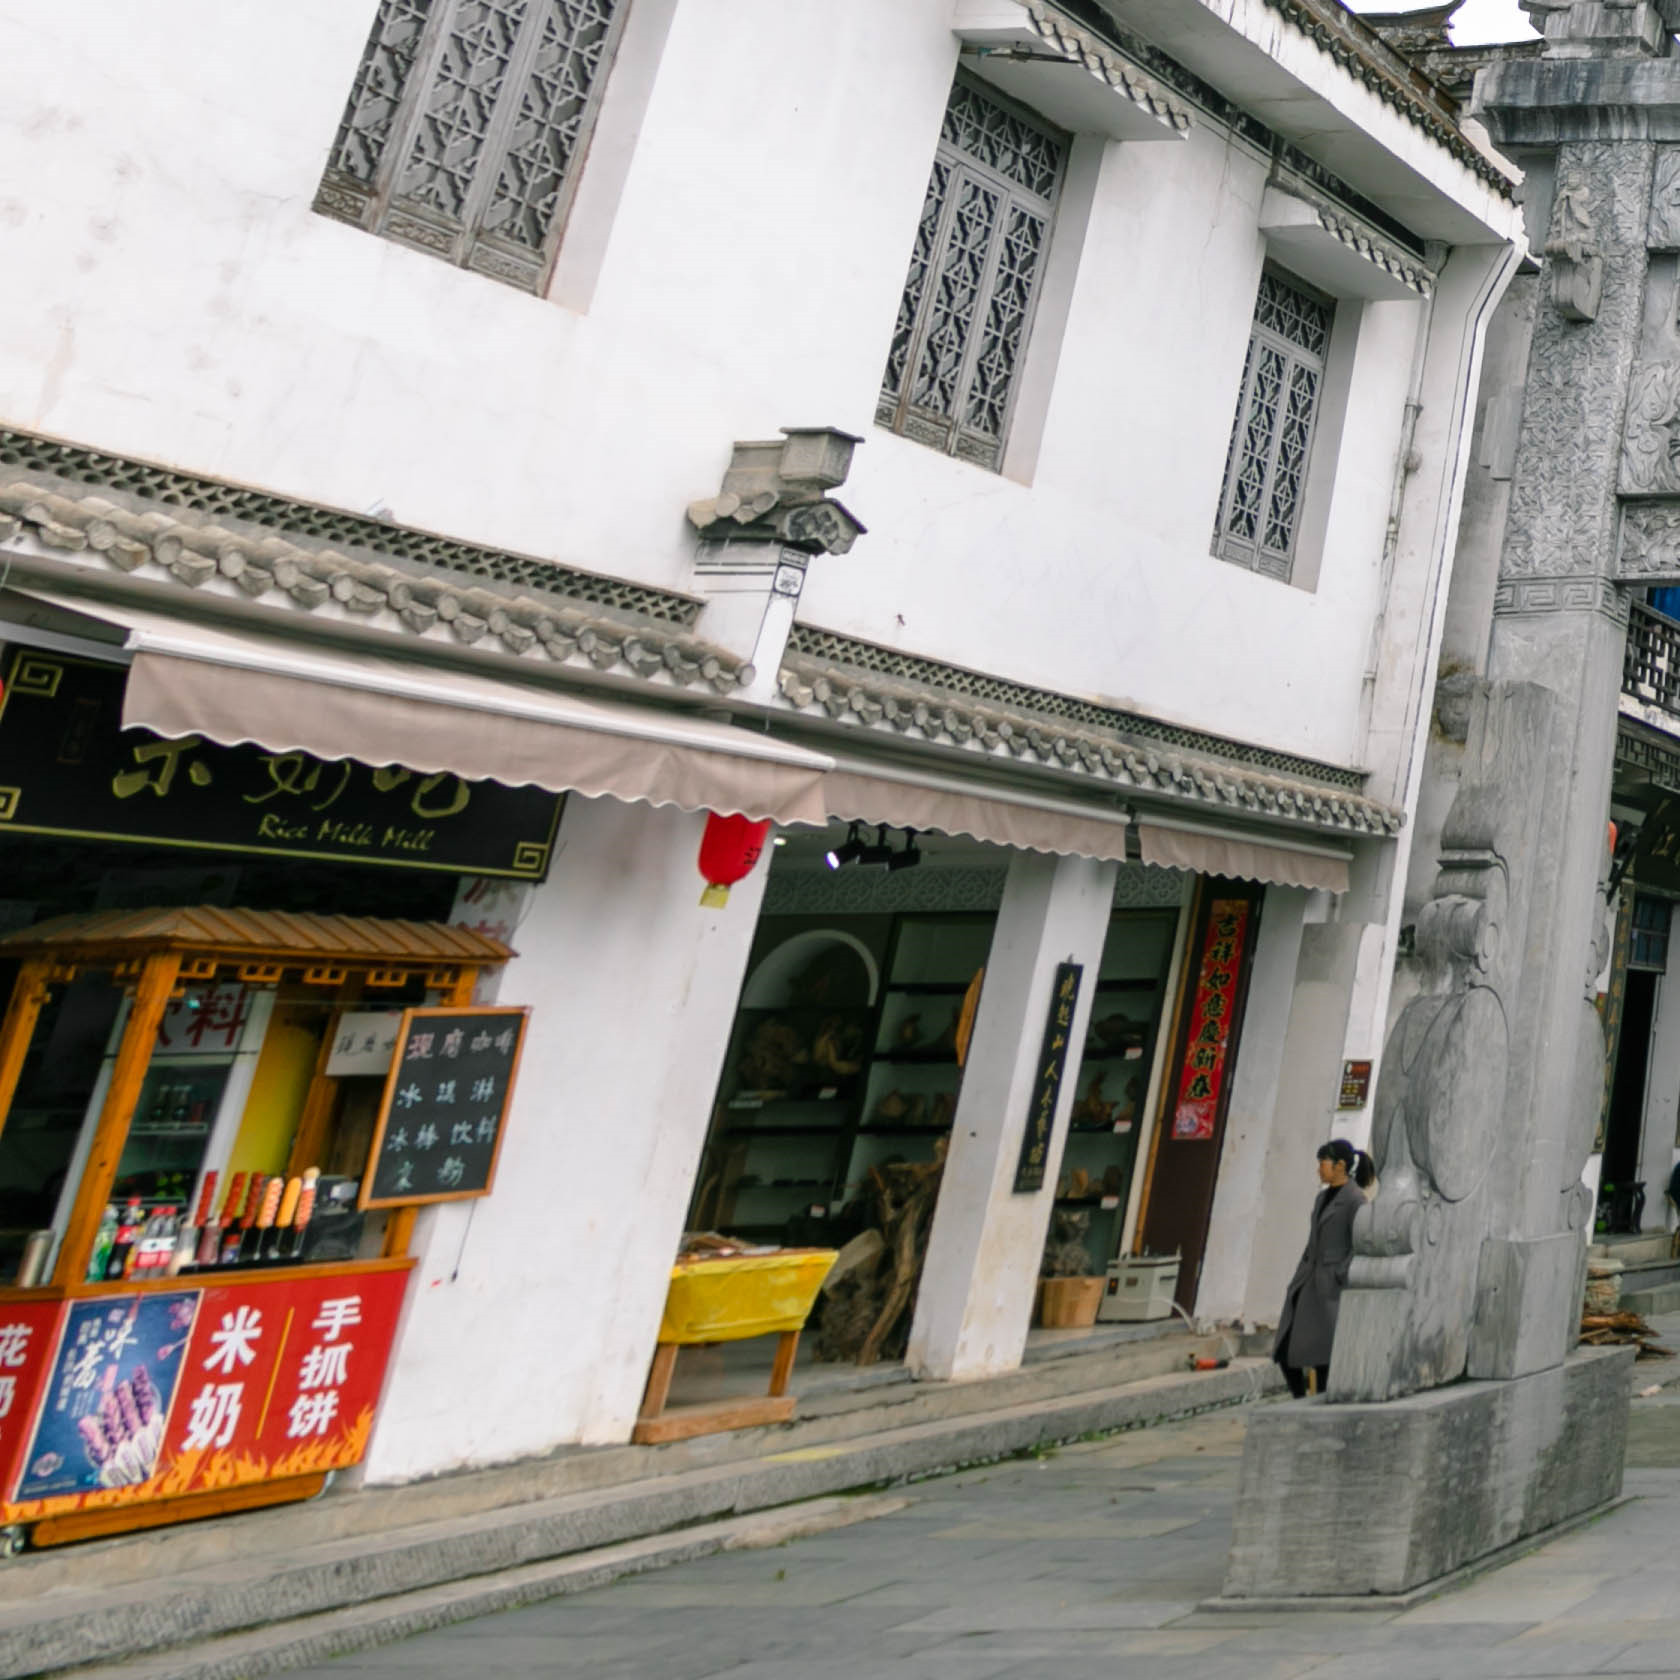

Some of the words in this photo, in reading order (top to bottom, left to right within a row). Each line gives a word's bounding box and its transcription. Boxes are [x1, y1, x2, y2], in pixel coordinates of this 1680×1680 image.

[158, 987, 246, 1048] 料
[180, 1304, 263, 1453] 米奶
[287, 1295, 363, 1440] 手抓饼
